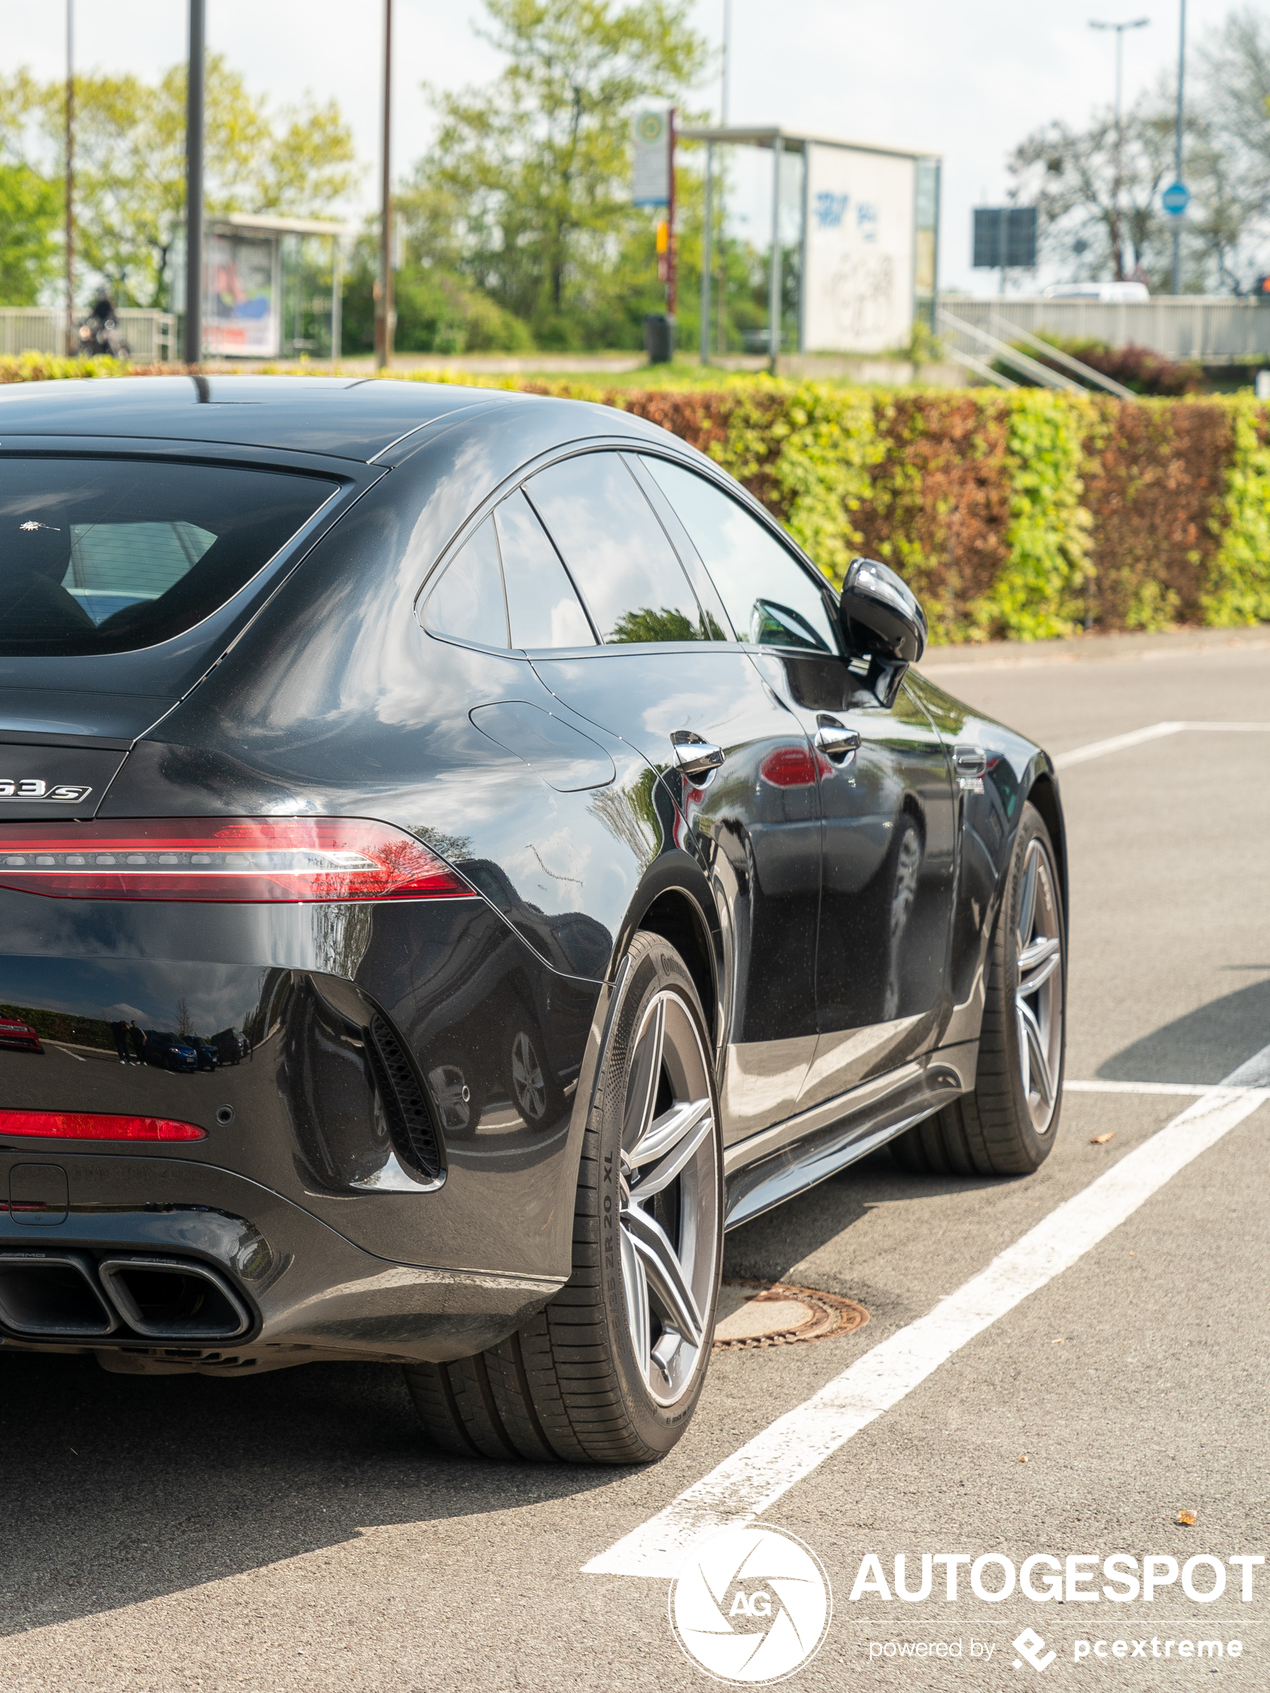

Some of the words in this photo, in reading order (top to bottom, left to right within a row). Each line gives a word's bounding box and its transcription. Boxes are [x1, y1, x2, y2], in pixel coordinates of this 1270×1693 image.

[604, 1150, 612, 1184] XL
[603, 1194, 612, 1229] 20
[604, 1235, 614, 1270] ZR
